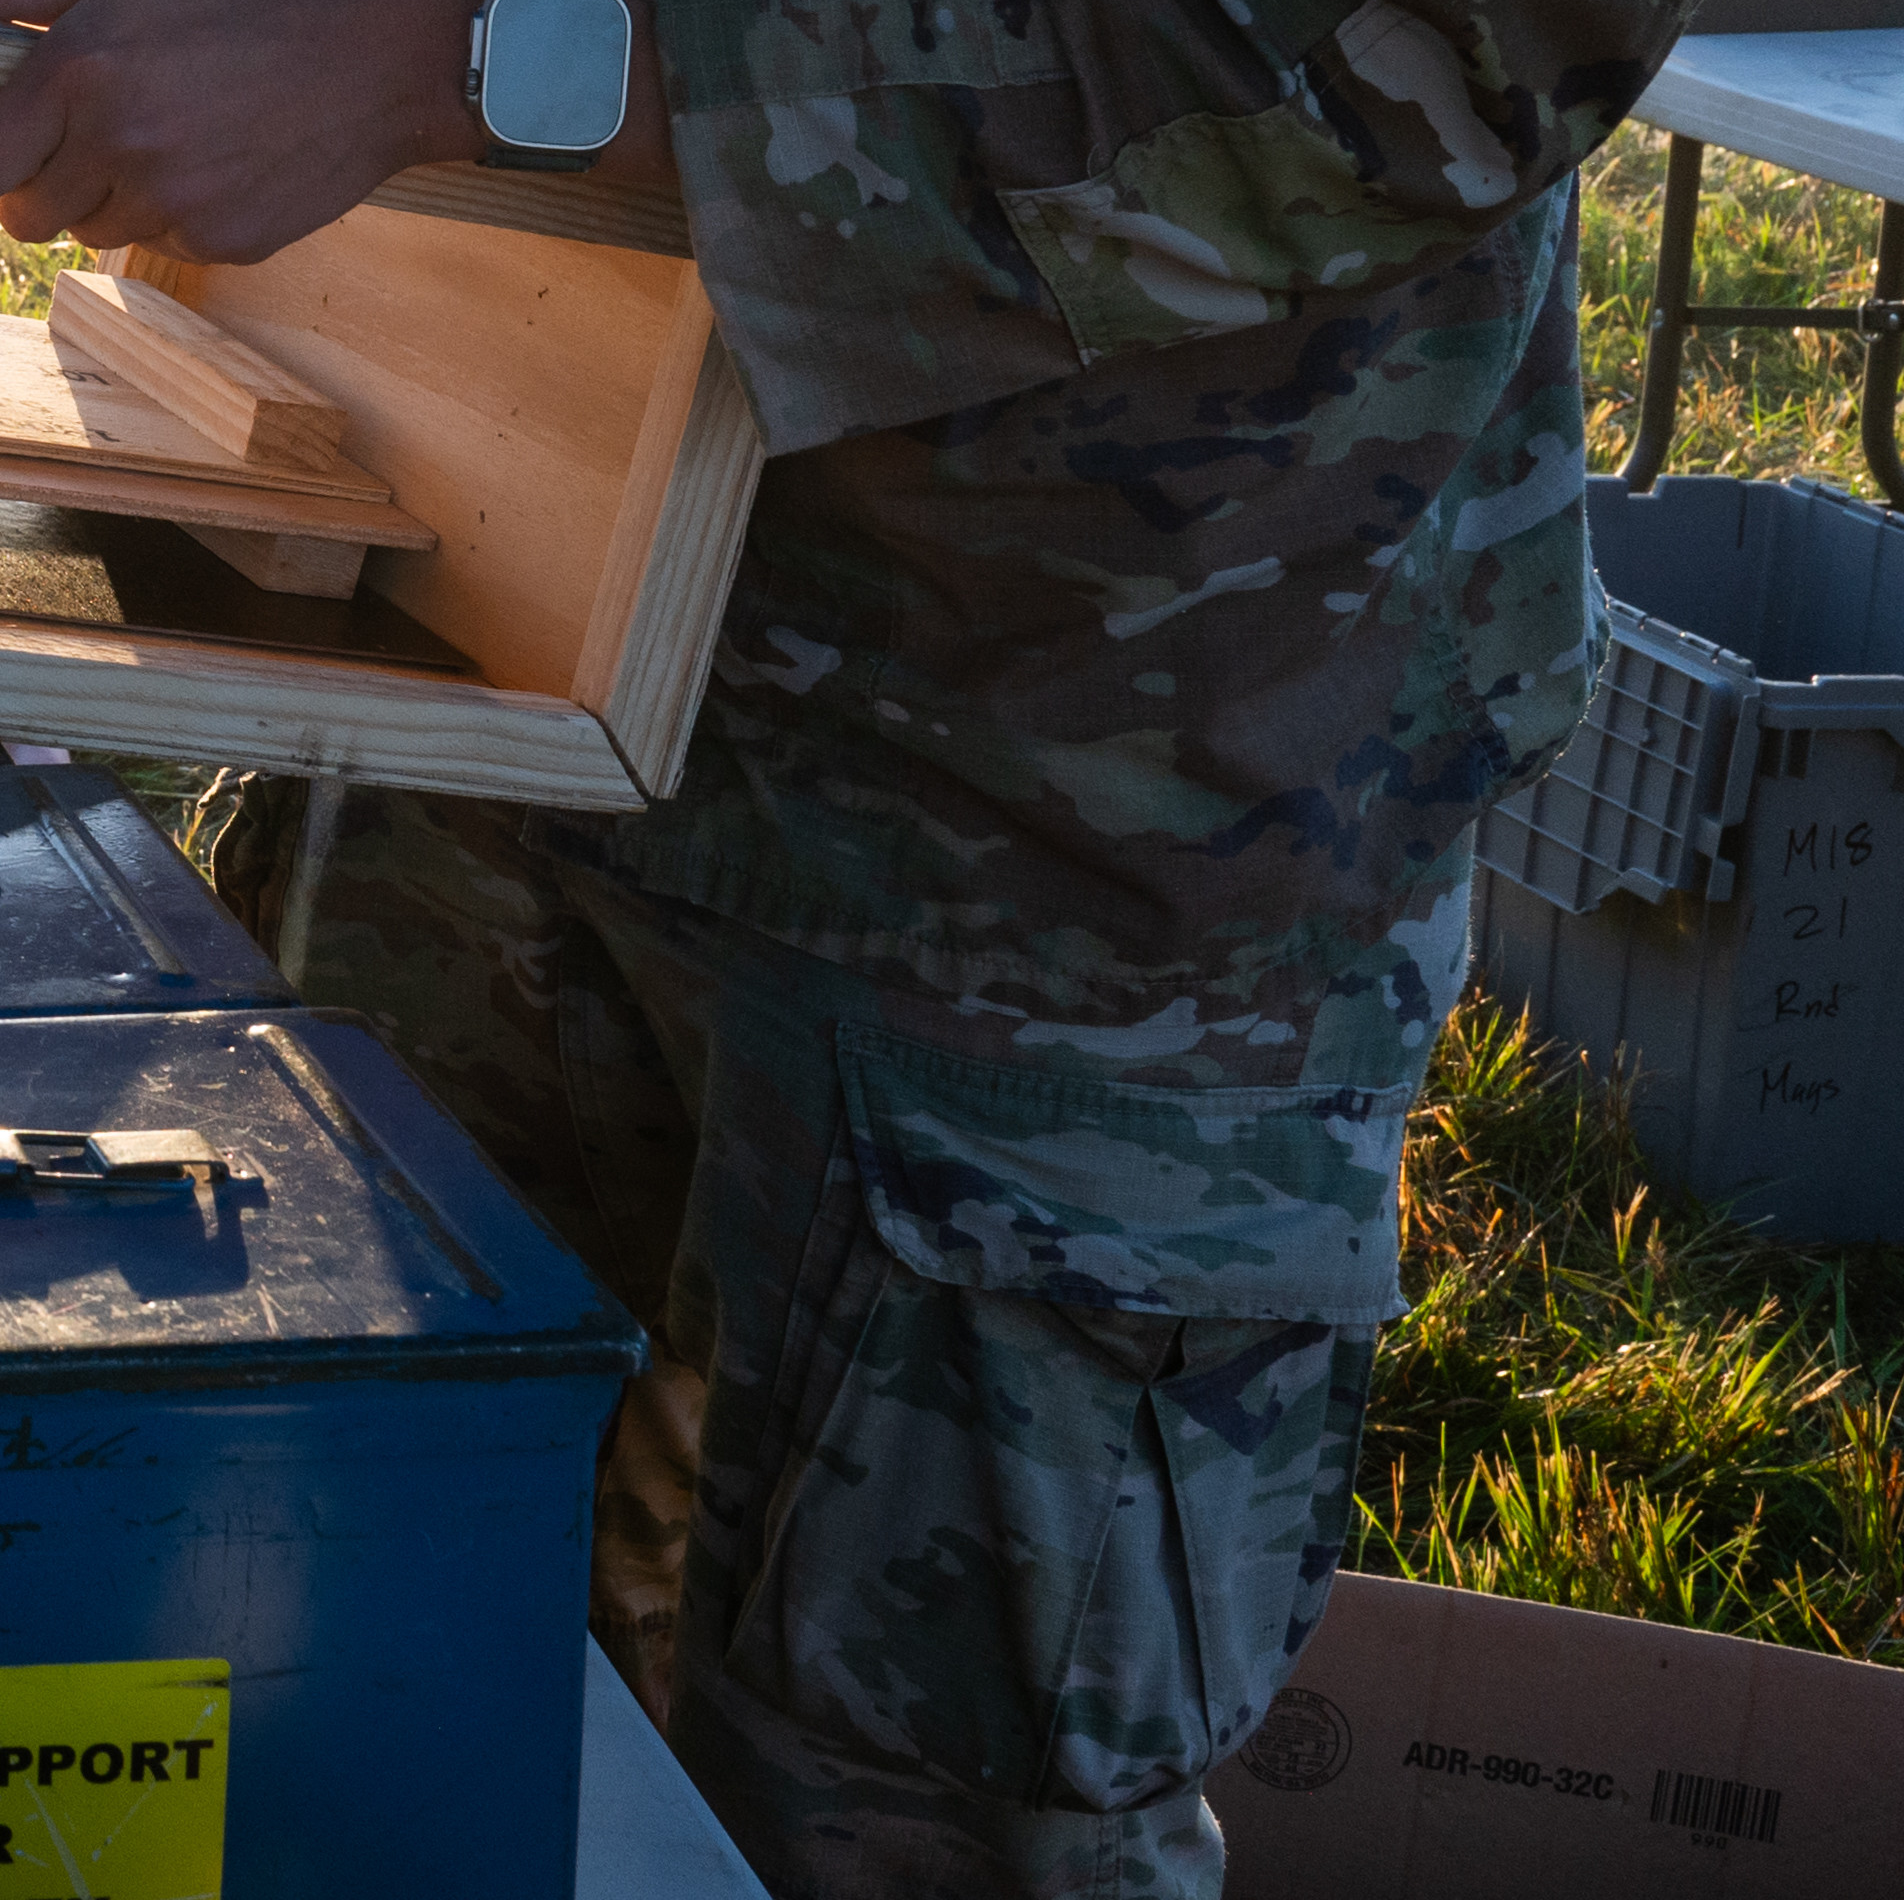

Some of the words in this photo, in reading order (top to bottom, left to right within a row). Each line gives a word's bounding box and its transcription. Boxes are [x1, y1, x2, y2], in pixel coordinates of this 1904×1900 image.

[1783, 822, 1873, 877] M18
[1783, 896, 1847, 940] 21
[1774, 980, 1840, 1023] Rnd
[1759, 1061, 1842, 1115] Mags
[1402, 1740, 1615, 1801] ADR-990-32C
[1691, 1832, 1728, 1850] 990
